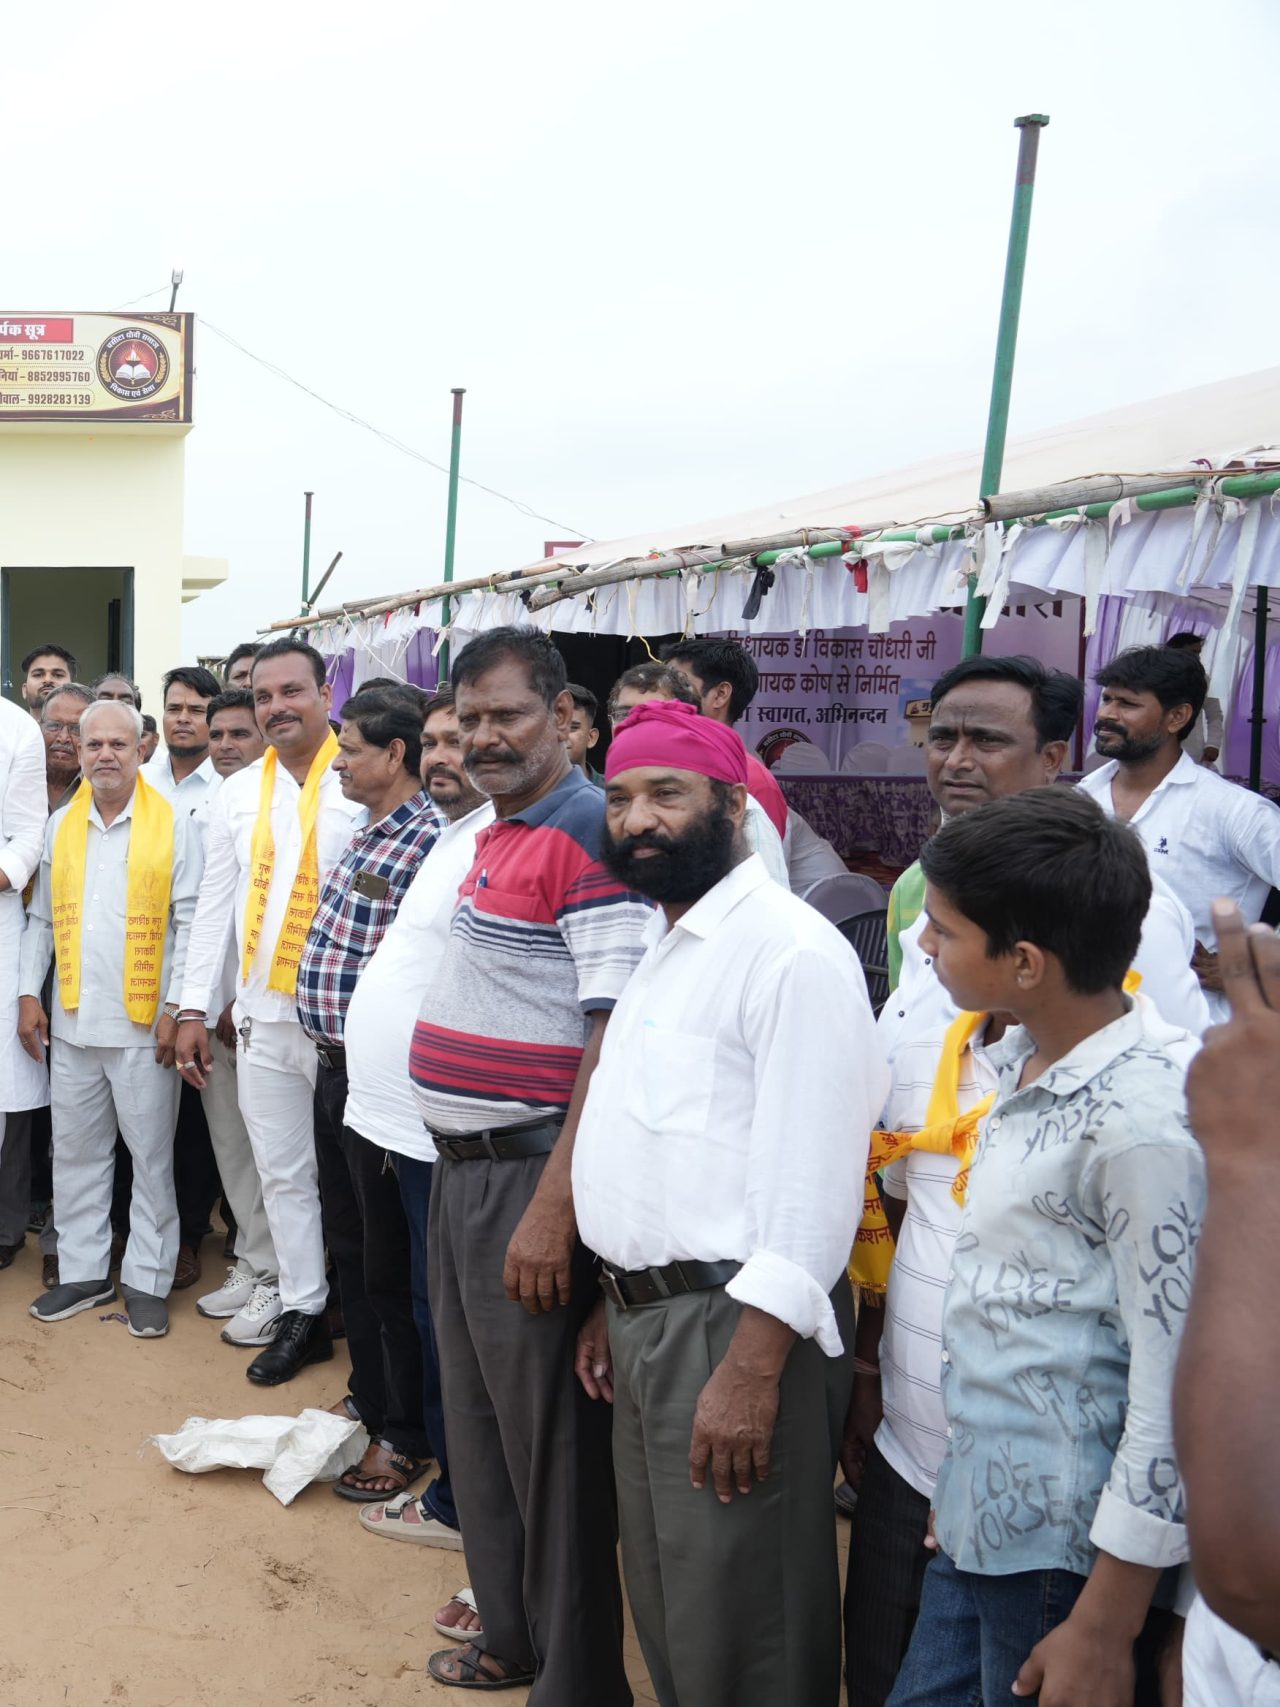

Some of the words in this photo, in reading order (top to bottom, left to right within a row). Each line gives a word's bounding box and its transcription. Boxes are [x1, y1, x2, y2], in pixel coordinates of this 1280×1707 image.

[24, 323, 47, 340] सूत्र
[21, 349, 85, 361] 9667617022
[27, 371, 91, 382] 8852995760
[27, 394, 91, 405] 9928283139
[814, 629, 865, 659] विकास
[868, 630, 913, 660] चौधरी
[916, 630, 937, 661] जी
[800, 664, 833, 694] कोष
[836, 665, 851, 694] से
[855, 665, 901, 696] निर्मित
[816, 702, 889, 725] अभिनन्दन
